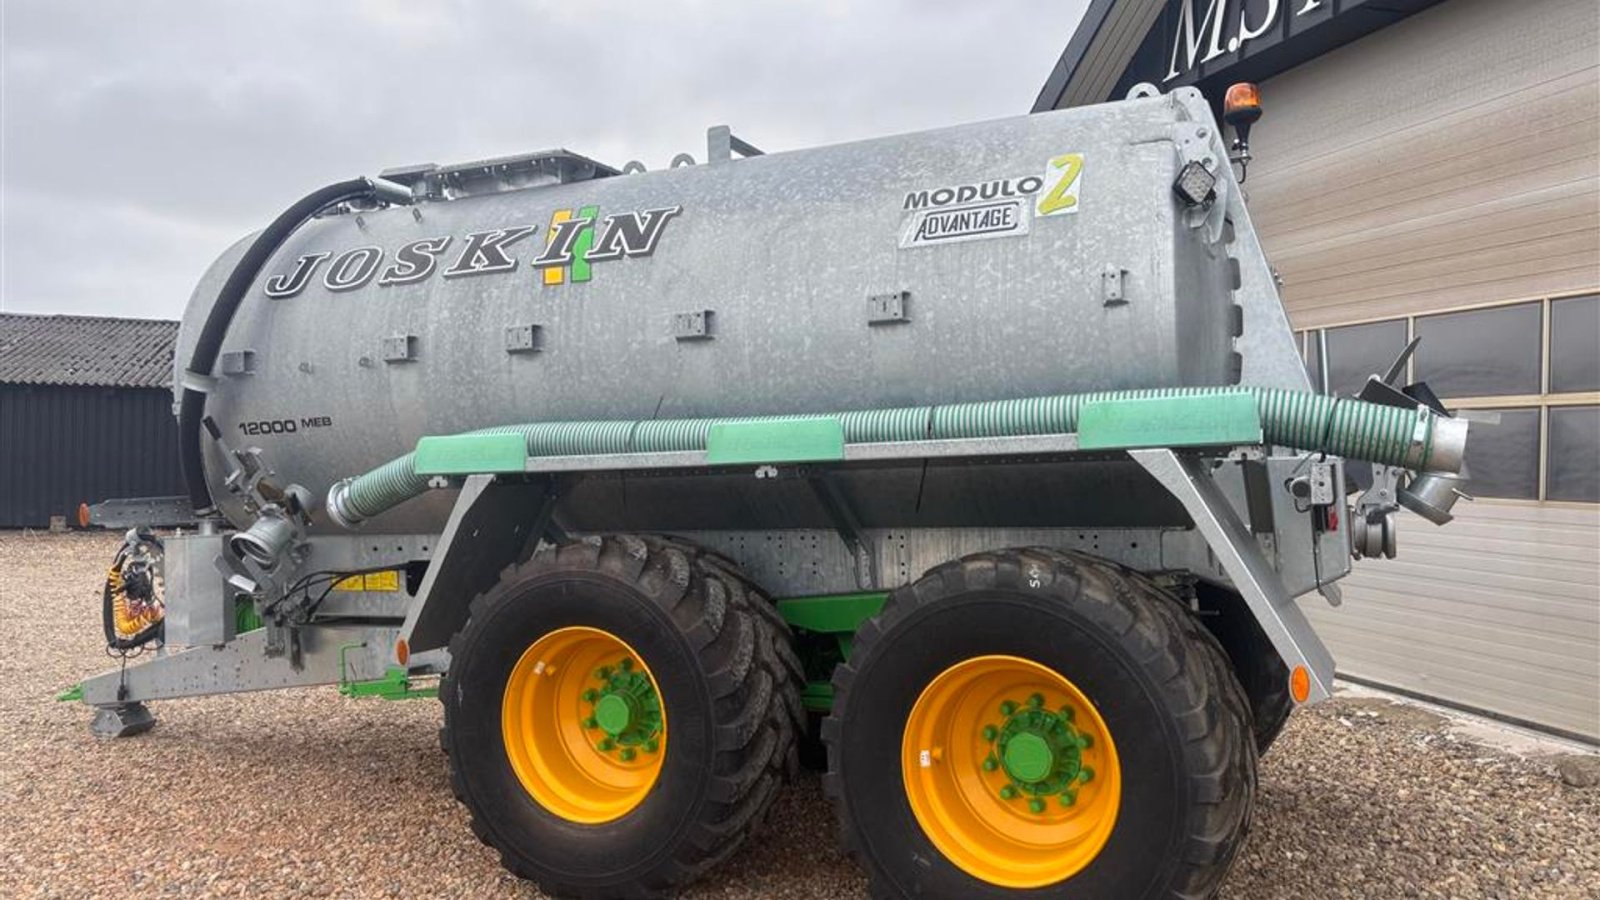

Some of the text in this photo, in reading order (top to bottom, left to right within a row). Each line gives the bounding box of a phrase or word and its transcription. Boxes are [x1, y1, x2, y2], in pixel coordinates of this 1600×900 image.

[903, 153, 1085, 215] MODULO 2
[913, 206, 1013, 242] ADVANTAGE
[263, 205, 682, 299] JOSKIN
[239, 416, 332, 436] 12000 MEB
